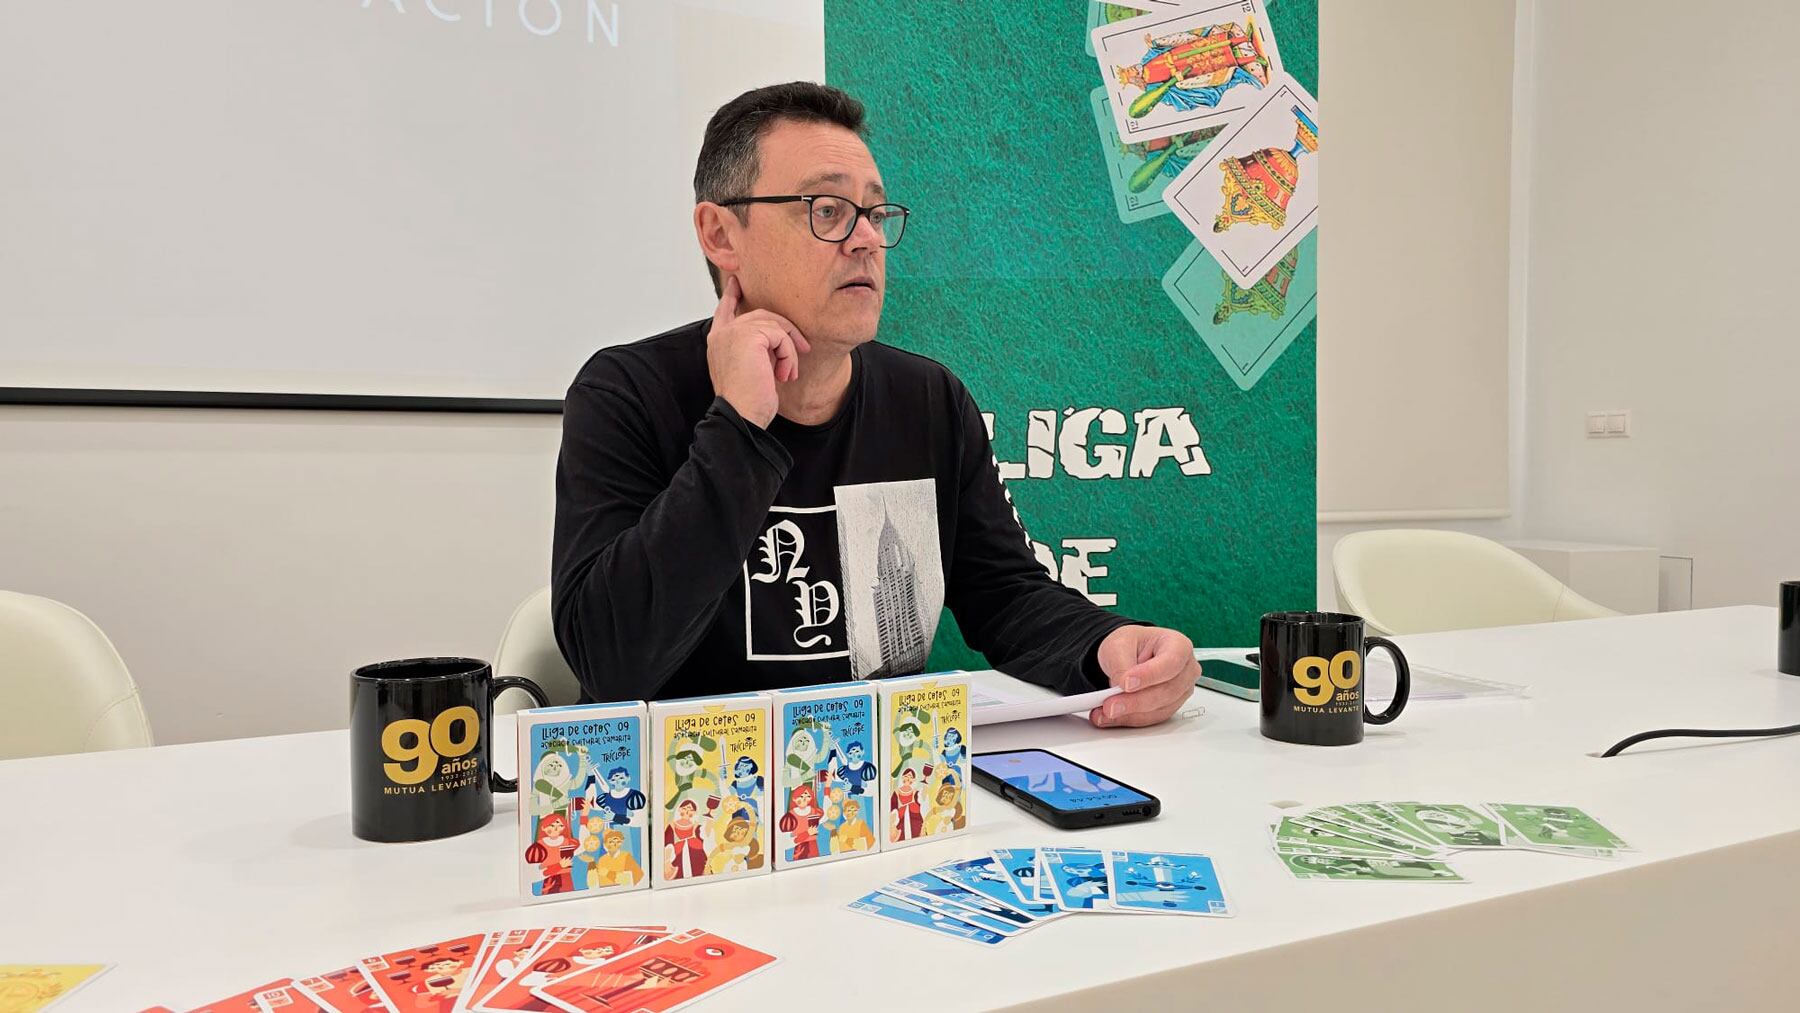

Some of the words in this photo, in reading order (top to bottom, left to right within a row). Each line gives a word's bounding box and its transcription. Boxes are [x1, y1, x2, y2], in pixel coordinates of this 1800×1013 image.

[1292, 650, 1361, 706] 90
[951, 688, 960, 697] 09
[1336, 690, 1359, 702] años
[853, 699, 864, 708] 09
[1293, 705, 1325, 714] MUTUA
[1328, 705, 1360, 714] LEVANTE
[744, 713, 756, 722] 09
[617, 721, 629, 731] 09
[381, 705, 480, 785] 90
[441, 757, 478, 774] años
[384, 785, 425, 795] MUTUA
[431, 776, 477, 792] LEVANTE
